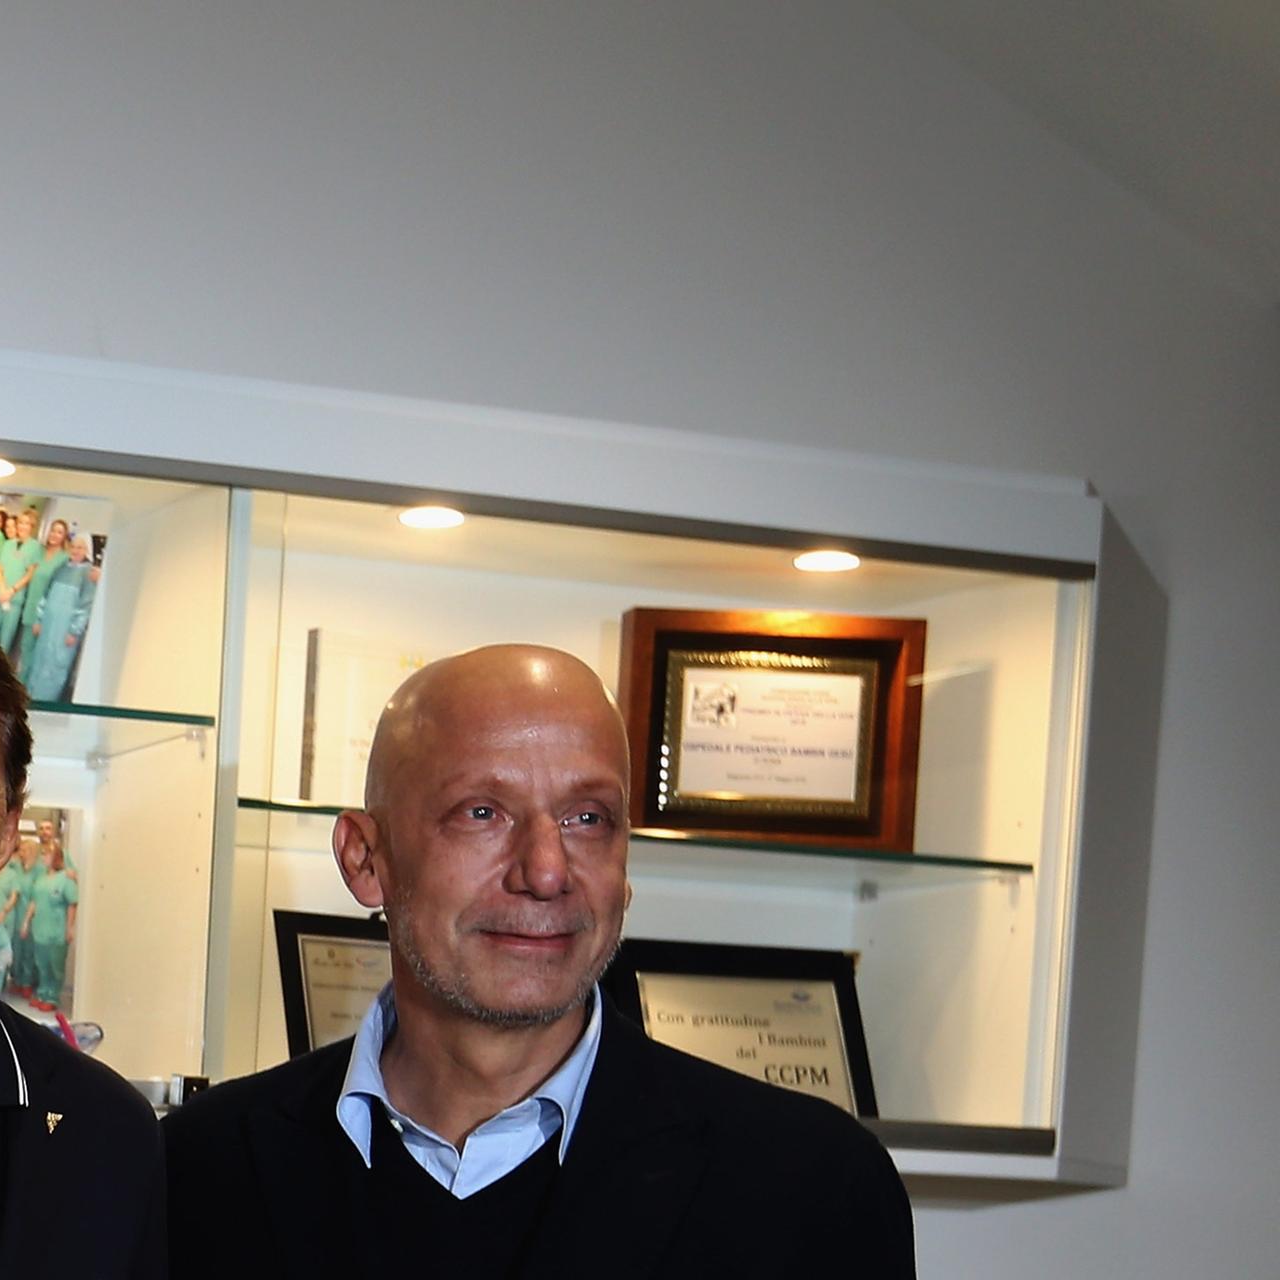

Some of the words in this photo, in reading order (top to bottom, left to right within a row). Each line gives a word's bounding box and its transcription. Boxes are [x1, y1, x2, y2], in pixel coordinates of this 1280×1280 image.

[657, 1010, 685, 1024] Con
[692, 1012, 770, 1028] gratitudine
[767, 1032, 827, 1048] Bambini
[764, 1064, 830, 1086] CCPM
